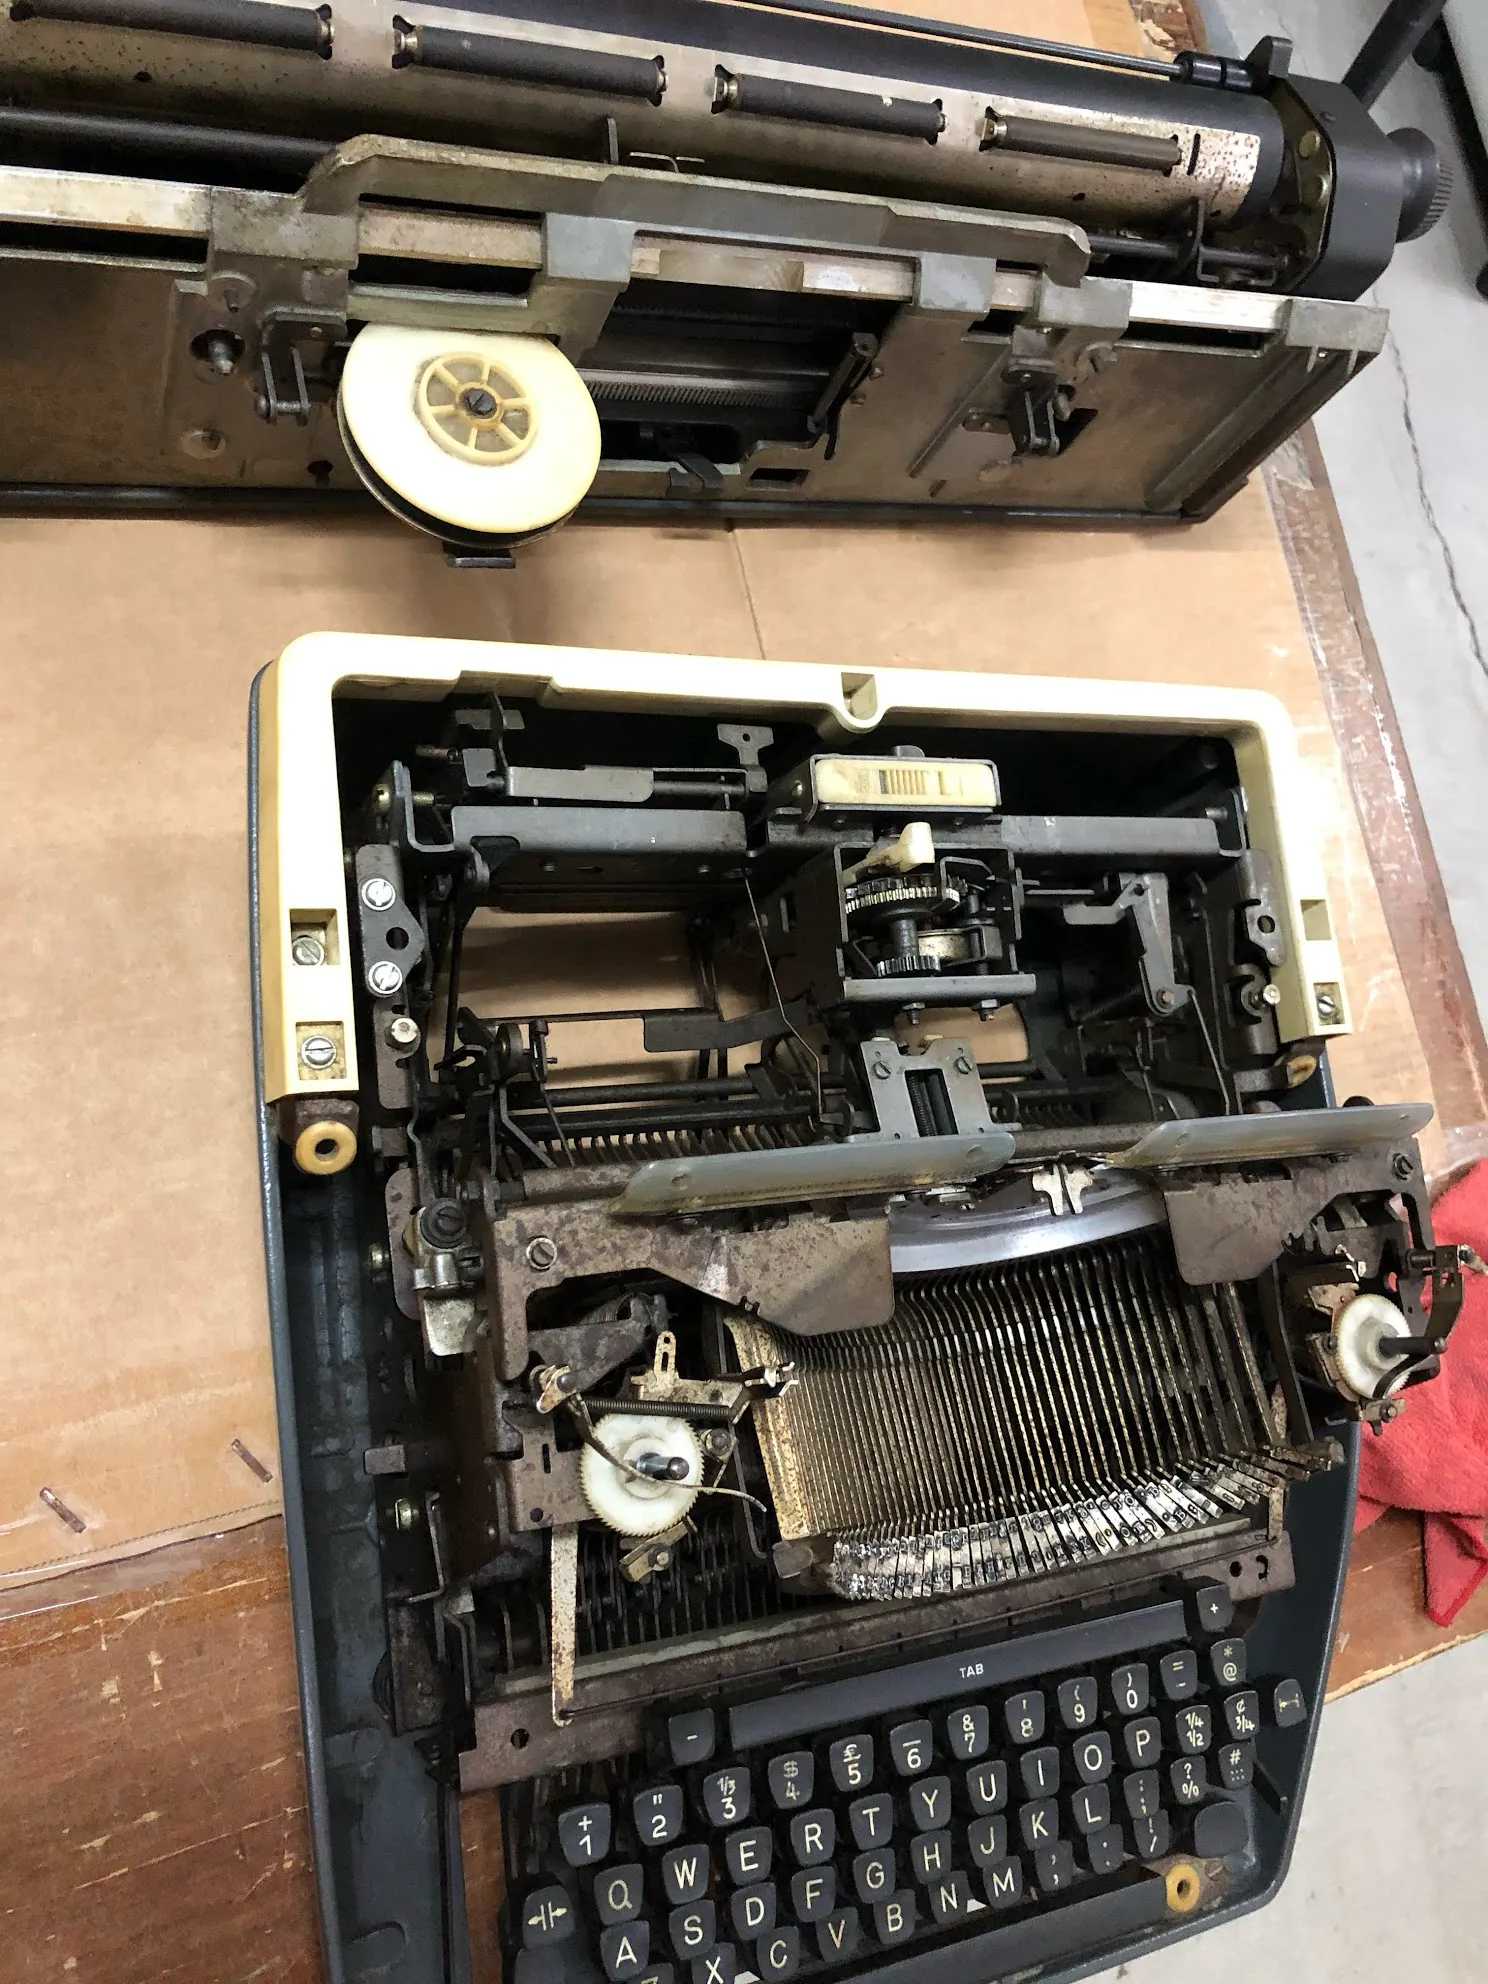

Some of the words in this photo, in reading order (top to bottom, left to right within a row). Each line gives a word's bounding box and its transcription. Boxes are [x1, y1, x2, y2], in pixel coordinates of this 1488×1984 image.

[959, 1663, 984, 1679] TAB
[578, 1834, 592, 1856] 1
[651, 1814, 668, 1839] 2
[721, 1796, 737, 1820] 3
[785, 1781, 800, 1801] 4
[847, 1764, 862, 1785] 5
[906, 1747, 922, 1769] 6
[964, 1731, 977, 1753] 7
[1020, 1717, 1034, 1738] 8
[1074, 1703, 1086, 1723] 9
[1126, 1689, 1139, 1709] 0
[1222, 1662, 1237, 1682] @
[783, 1760, 799, 1778] $
[843, 1743, 862, 1764] £
[962, 1714, 975, 1732] &
[1183, 1762, 1192, 1780] ?
[1229, 1748, 1242, 1766] #
[608, 1879, 633, 1910] Q
[674, 1856, 697, 1890] W
[739, 1839, 759, 1872] E
[804, 1823, 824, 1854] R
[862, 1806, 880, 1836] T
[921, 1788, 939, 1818] Y
[979, 1773, 997, 1802] U
[1083, 1744, 1103, 1771] O
[1135, 1729, 1151, 1757] P
[615, 1936, 638, 1969] A
[683, 1915, 704, 1946] S
[745, 1896, 765, 1927] D
[805, 1878, 824, 1910] F
[866, 1861, 885, 1889] G
[923, 1842, 941, 1872] H
[980, 1826, 995, 1855] J
[1031, 1810, 1049, 1839] K
[1084, 1797, 1102, 1824] L
[705, 1955, 724, 1984] X
[769, 1939, 788, 1969] C
[827, 1919, 846, 1949] V
[886, 1903, 903, 1933] B
[940, 1883, 958, 1913] N
[992, 1867, 1015, 1898] M
